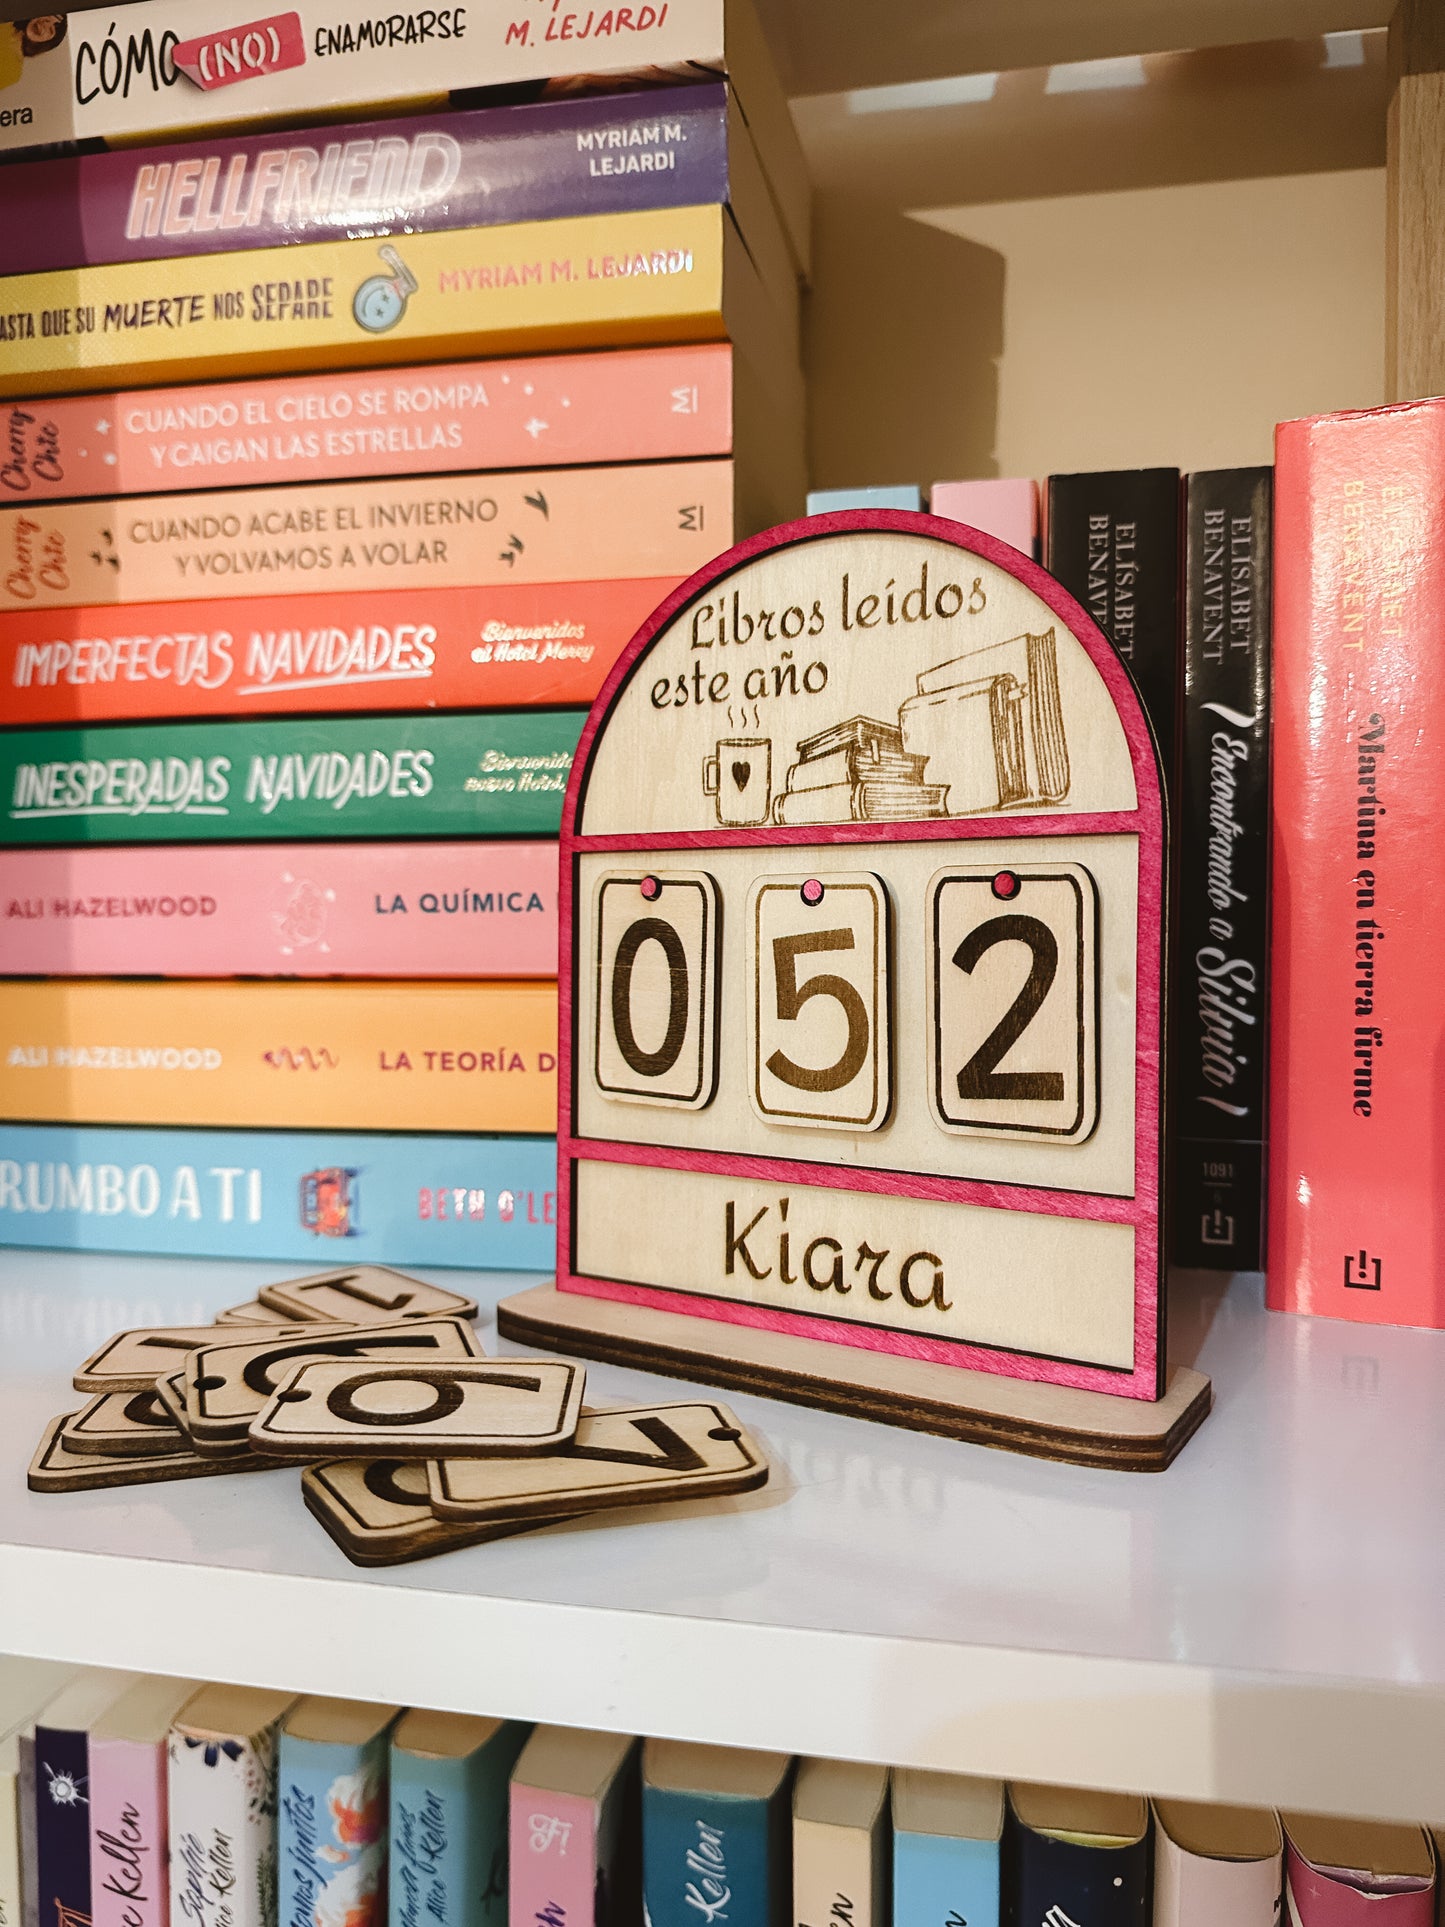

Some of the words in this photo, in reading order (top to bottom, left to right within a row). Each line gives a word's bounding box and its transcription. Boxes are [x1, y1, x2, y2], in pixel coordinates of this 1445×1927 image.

[76, 22, 180, 105] CÓMO
[199, 26, 281, 81] (NO)
[314, 8, 466, 57] ENAMORARSE
[505, 20, 535, 47] M.
[545, 3, 669, 41] LEJARDI
[577, 126, 659, 151] MYRIAM
[664, 124, 687, 141] M.
[590, 152, 675, 176] LEJARDI
[125, 133, 462, 239] HELLFRIEND
[439, 261, 543, 294] MYRIAM
[551, 259, 578, 283] M.
[587, 248, 693, 280] LEJARDI
[42, 308, 71, 338] QUE
[76, 306, 96, 334] SU
[103, 295, 205, 332] MUERTE
[214, 291, 245, 320] NOS
[252, 278, 334, 322] SEPARE
[124, 401, 239, 434] CUANDO
[244, 399, 271, 425] EL
[275, 391, 354, 424] CIELO
[358, 389, 387, 416] SE
[394, 383, 489, 414] ROMPA
[0, 405, 36, 491] Cherry
[32, 420, 64, 482] Chic
[149, 446, 168, 468] Y
[168, 438, 270, 468] CAIGAN
[273, 435, 320, 460] LAS
[327, 423, 463, 458] ESTRELLAS
[129, 515, 241, 544] CUANDO
[249, 508, 329, 537] ACABE
[336, 507, 361, 530] EL
[368, 498, 498, 529] INVIERNO
[5, 512, 41, 600] Cherry
[38, 528, 70, 591] Chic
[176, 555, 191, 577] Y
[193, 545, 332, 576] VOLVAMOS
[340, 545, 356, 569] A
[363, 541, 448, 567] VOLAR
[1202, 508, 1226, 666] BENAVENT
[1229, 516, 1254, 655] ELÍSABET
[689, 591, 827, 651] Libros
[841, 561, 988, 631] leídos
[1114, 522, 1140, 660] ELÍSABET
[13, 631, 234, 690] IMPERFECTAS
[245, 624, 437, 684] NAVIDADES
[650, 660, 731, 710] este
[744, 650, 829, 698] año
[13, 755, 231, 815] INESPERADAS
[246, 750, 436, 814] NAVIDADES
[1356, 712, 1387, 860] Martina
[1209, 730, 1250, 910] Encontrando
[8, 898, 44, 918] ALI
[53, 895, 218, 918] HAZELWOOD
[375, 894, 408, 914] LA
[419, 888, 545, 914] QUÍMICA
[1355, 868, 1377, 910] en
[1209, 915, 1234, 941] a
[1355, 923, 1386, 1018] tierra
[612, 917, 689, 1077] 0
[765, 927, 870, 1093] 5
[952, 914, 1064, 1101] 2
[1196, 946, 1257, 1088] Silvia
[7, 1046, 48, 1068] ALI
[53, 1046, 222, 1070] HAZELWOOD
[380, 1051, 412, 1072] LA
[424, 1047, 526, 1072] TEORÍA
[1352, 1027, 1384, 1119] firme
[0, 1159, 161, 1218] RUMBO
[168, 1164, 202, 1221] A
[209, 1167, 262, 1223] TI
[1203, 1162, 1233, 1177] 1091
[418, 1187, 486, 1222] BETH
[724, 1198, 954, 1312] Kiara
[96, 1802, 150, 1901] Kellen
[419, 1789, 448, 1861] Kellen
[209, 1828, 236, 1897] Kellen
[685, 1820, 731, 1923] Kellen
[426, 1879, 448, 1923] Alice
